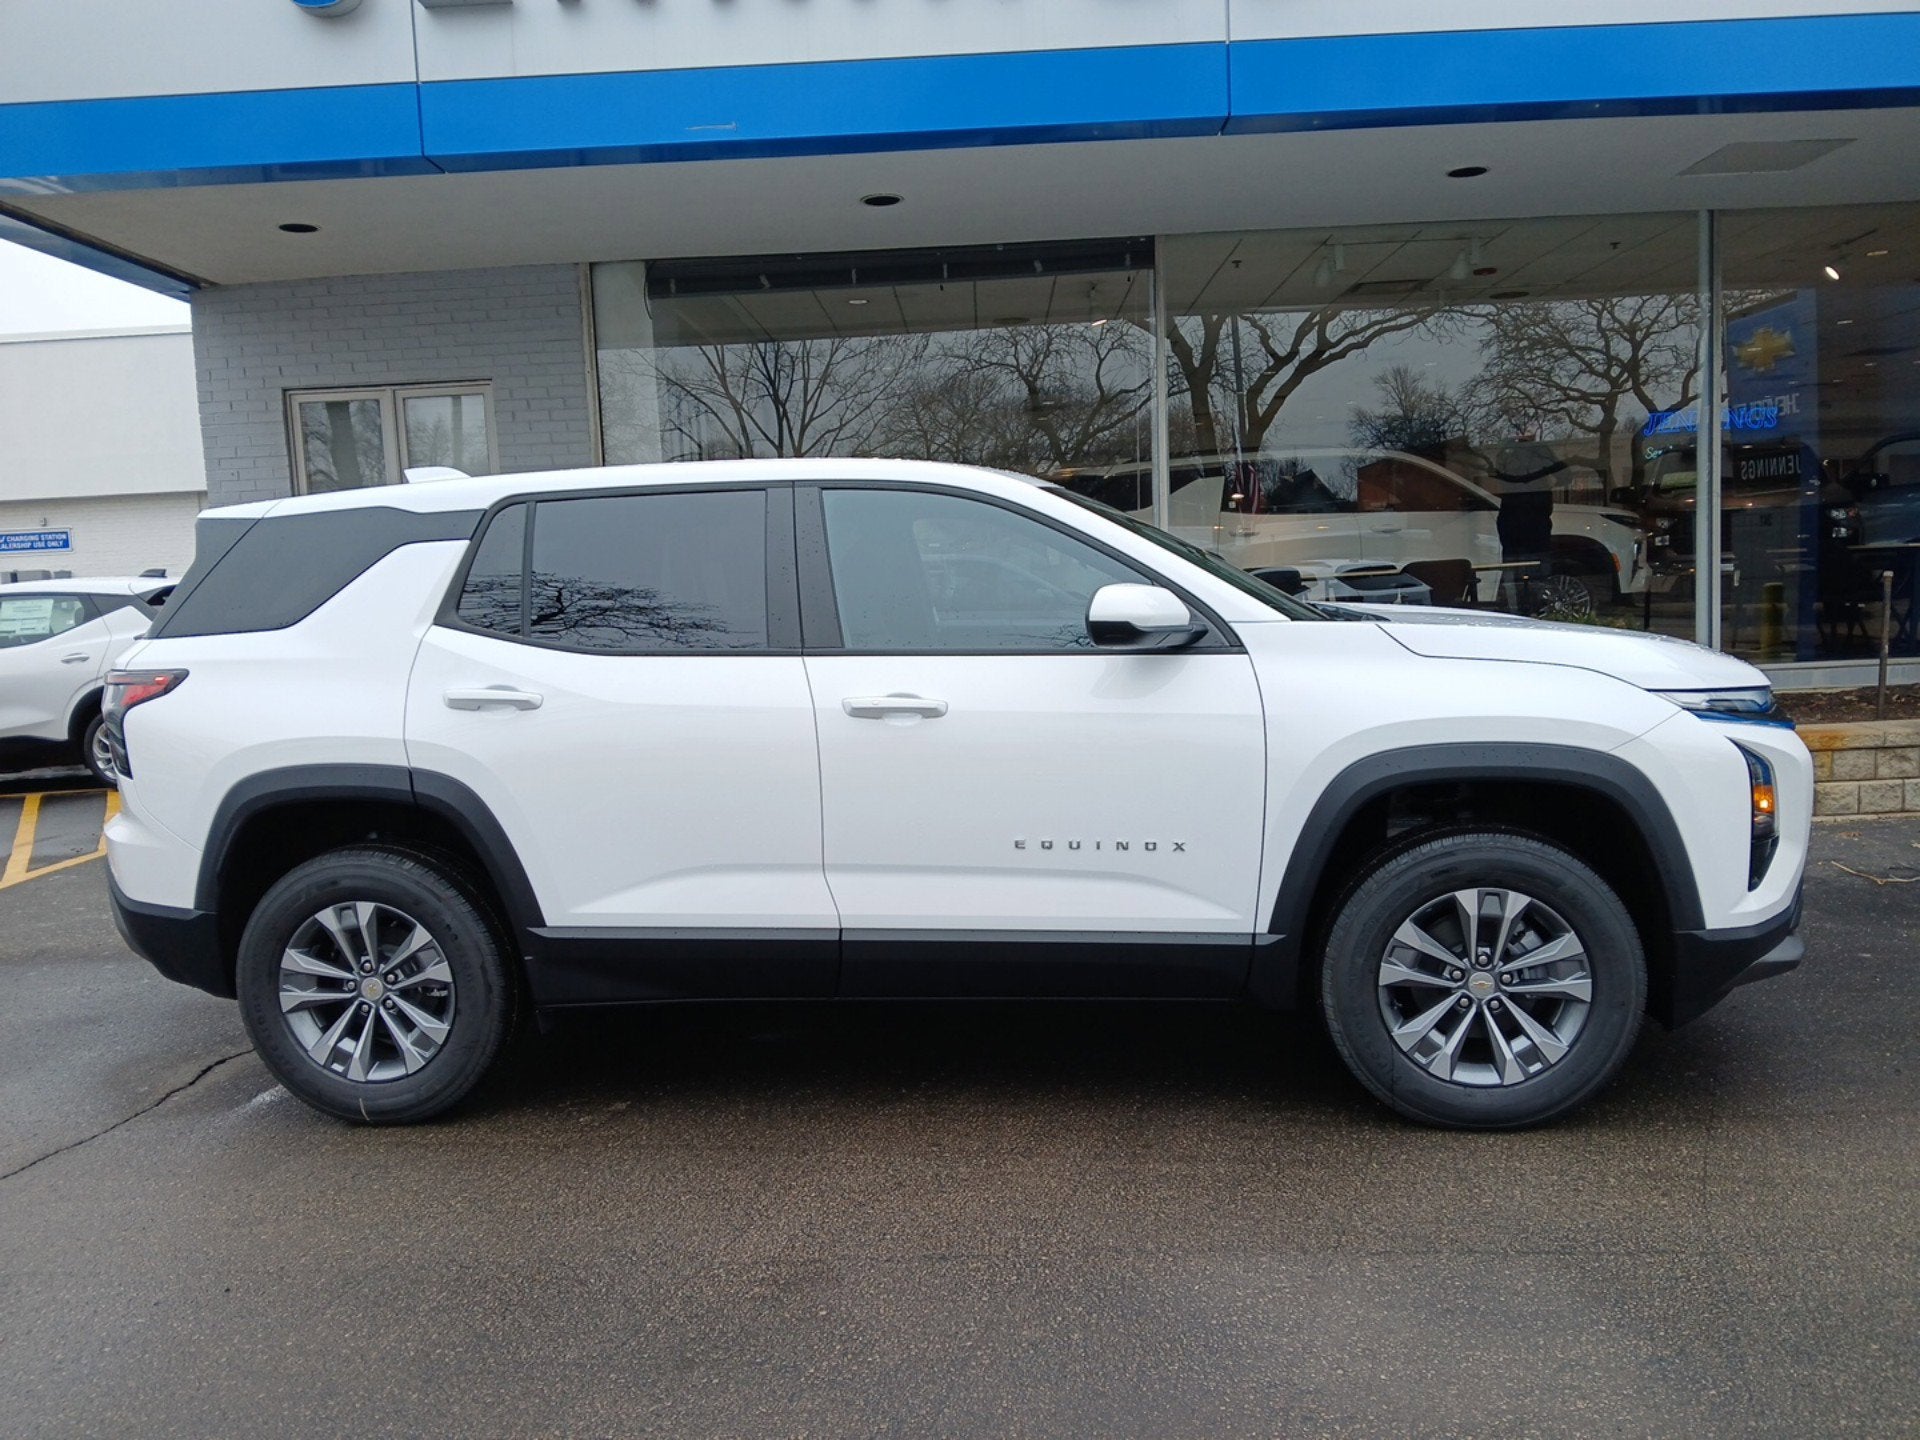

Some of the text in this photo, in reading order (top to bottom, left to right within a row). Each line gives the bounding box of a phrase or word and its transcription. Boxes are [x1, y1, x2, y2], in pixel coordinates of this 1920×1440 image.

[1644, 407, 1777, 436] JENNGS
[41, 533, 67, 541] STATION
[33, 540, 46, 548] USE
[47, 540, 64, 548] ONLY
[1014, 839, 1186, 852] EQUINOX
